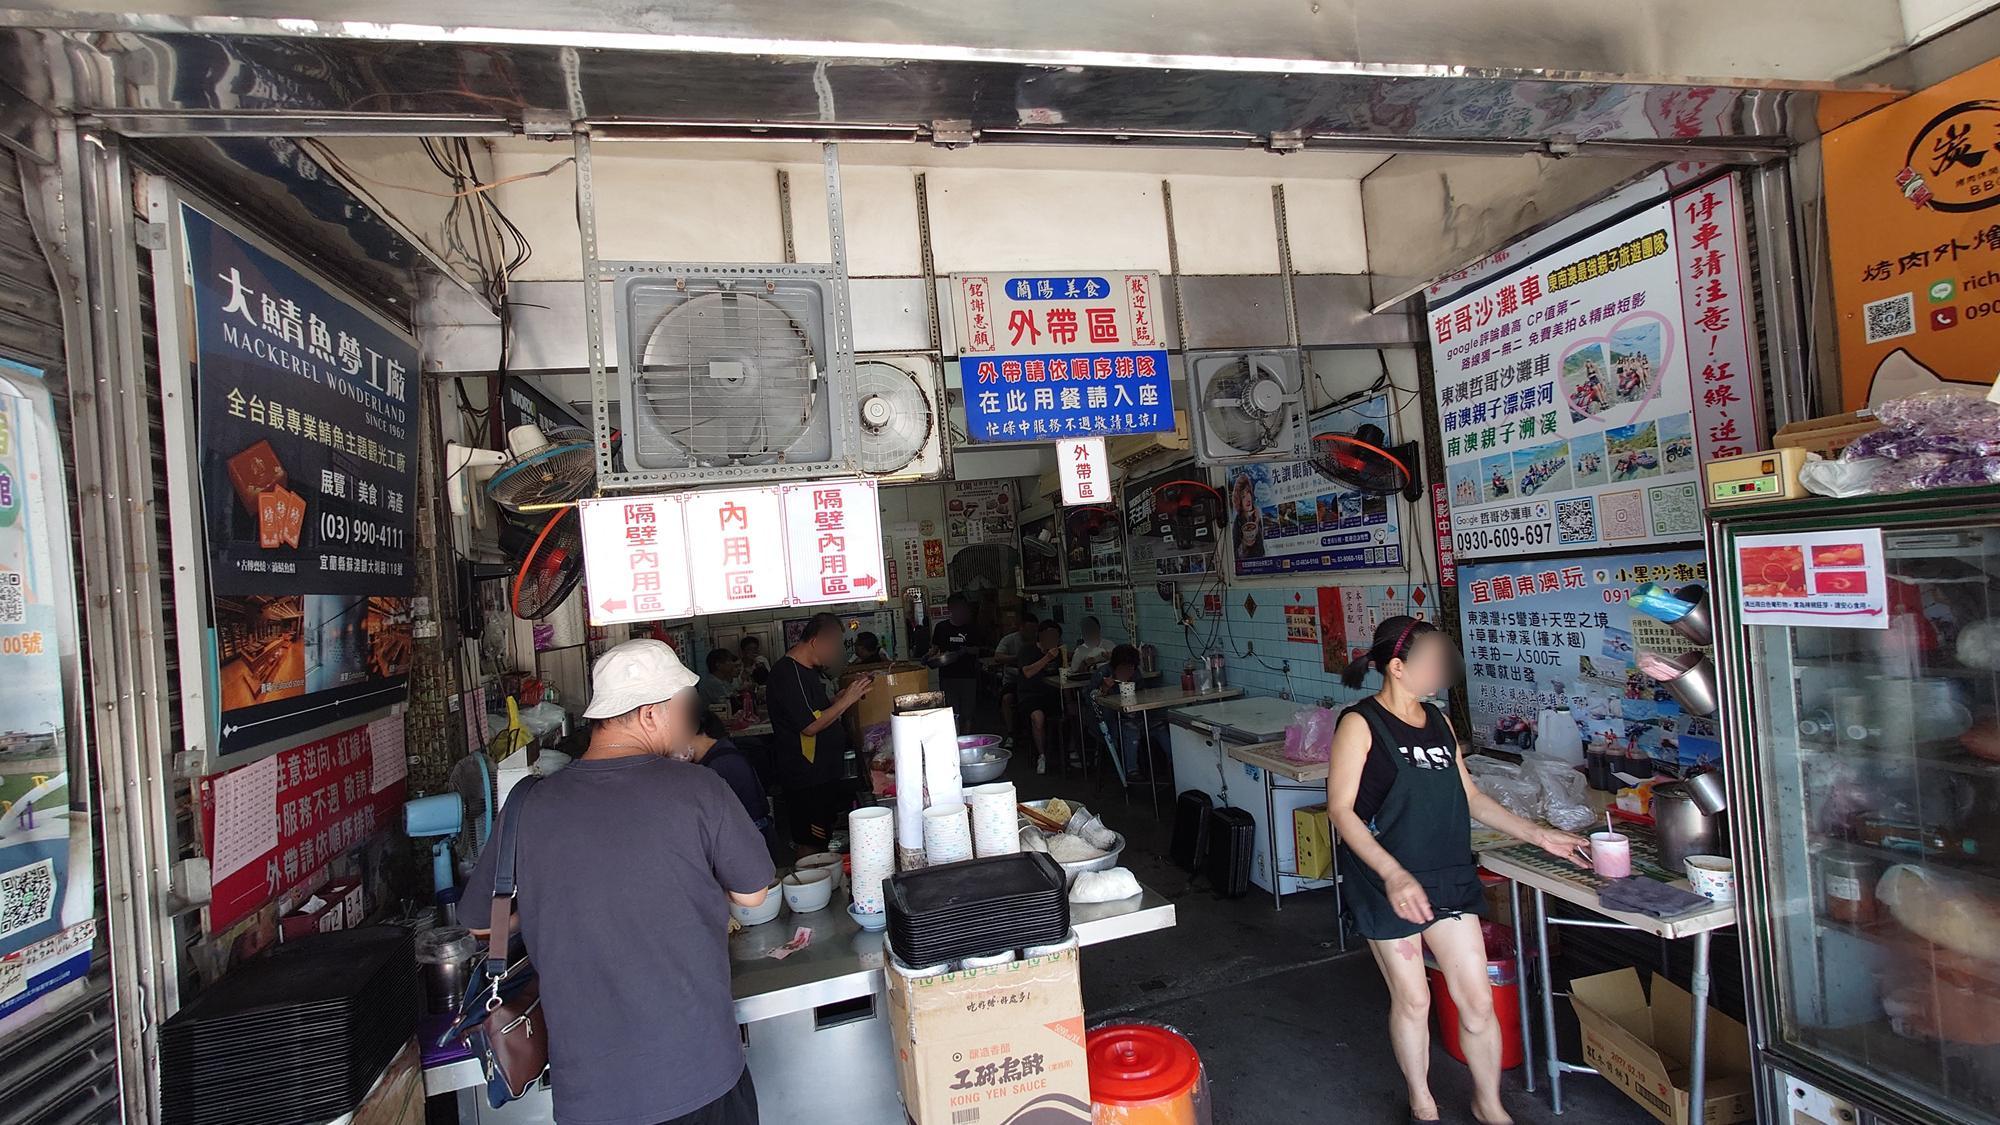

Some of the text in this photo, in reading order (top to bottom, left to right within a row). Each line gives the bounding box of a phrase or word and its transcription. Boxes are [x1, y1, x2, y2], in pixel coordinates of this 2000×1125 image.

[1929, 122, 2000, 177] 炭
[1547, 229, 1669, 293] 東南澳最強親子旅遊團隊
[1016, 279, 1100, 299] 蘭陽 美食
[969, 284, 990, 346] 銘謝惠顧
[1008, 308, 1120, 346] 外帶區
[1435, 273, 1543, 345] 哲哥沙灘車
[1526, 298, 1581, 328] CP值第一
[218, 267, 406, 402] 大鯖魚夢工廠
[223, 322, 405, 423] MACKEREL WONDERLAND
[977, 356, 1157, 384] 外帶請依順序排隊
[1461, 338, 1523, 371] 路線獨一無二
[978, 383, 1159, 414] 在此用餐請入座
[1441, 353, 1551, 407] 東澳哲哥沙灘車
[986, 412, 1157, 436] 忙碌中服務不週敬請見諒!
[1444, 381, 1554, 432] 南澳親子漂漂河
[227, 387, 406, 474] 全台最專業鯖魚主題觀光工廠
[365, 412, 405, 440] SINCE 1962
[1447, 410, 1557, 458] 南澳親子溯溪
[321, 469, 346, 499] 展覽
[358, 479, 378, 507] 美食
[1073, 444, 1095, 498] 外帶區
[320, 511, 404, 549] (03) 990-4111
[1456, 506, 1532, 527] Google 哲哥沙灘車
[718, 501, 756, 601] 內用區
[813, 488, 850, 596] 隔壁內用區
[1456, 523, 1552, 552] 0930-609-697
[623, 503, 665, 614] 隔壁內用區
[1470, 566, 1586, 604] 宜蘭東澳玩
[1473, 663, 1536, 684] 來電就出發
[950, 1078, 1047, 1108] KONG YEN SAUCE
